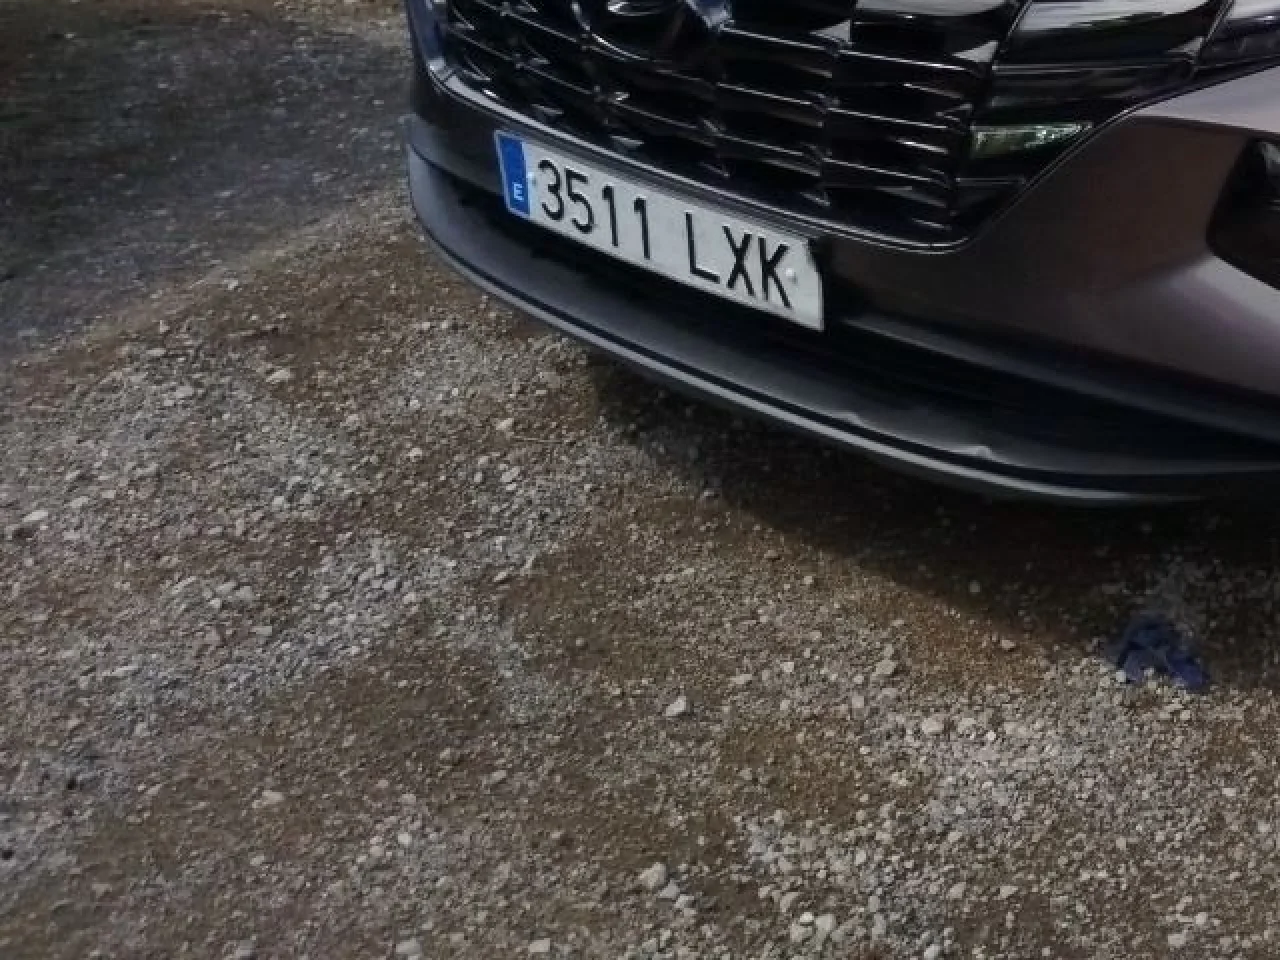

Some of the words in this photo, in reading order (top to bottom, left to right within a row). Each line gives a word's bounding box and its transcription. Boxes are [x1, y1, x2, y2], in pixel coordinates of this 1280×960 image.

[513, 183, 524, 201] E
[537, 159, 650, 260] 3511
[685, 211, 792, 309] LXK
